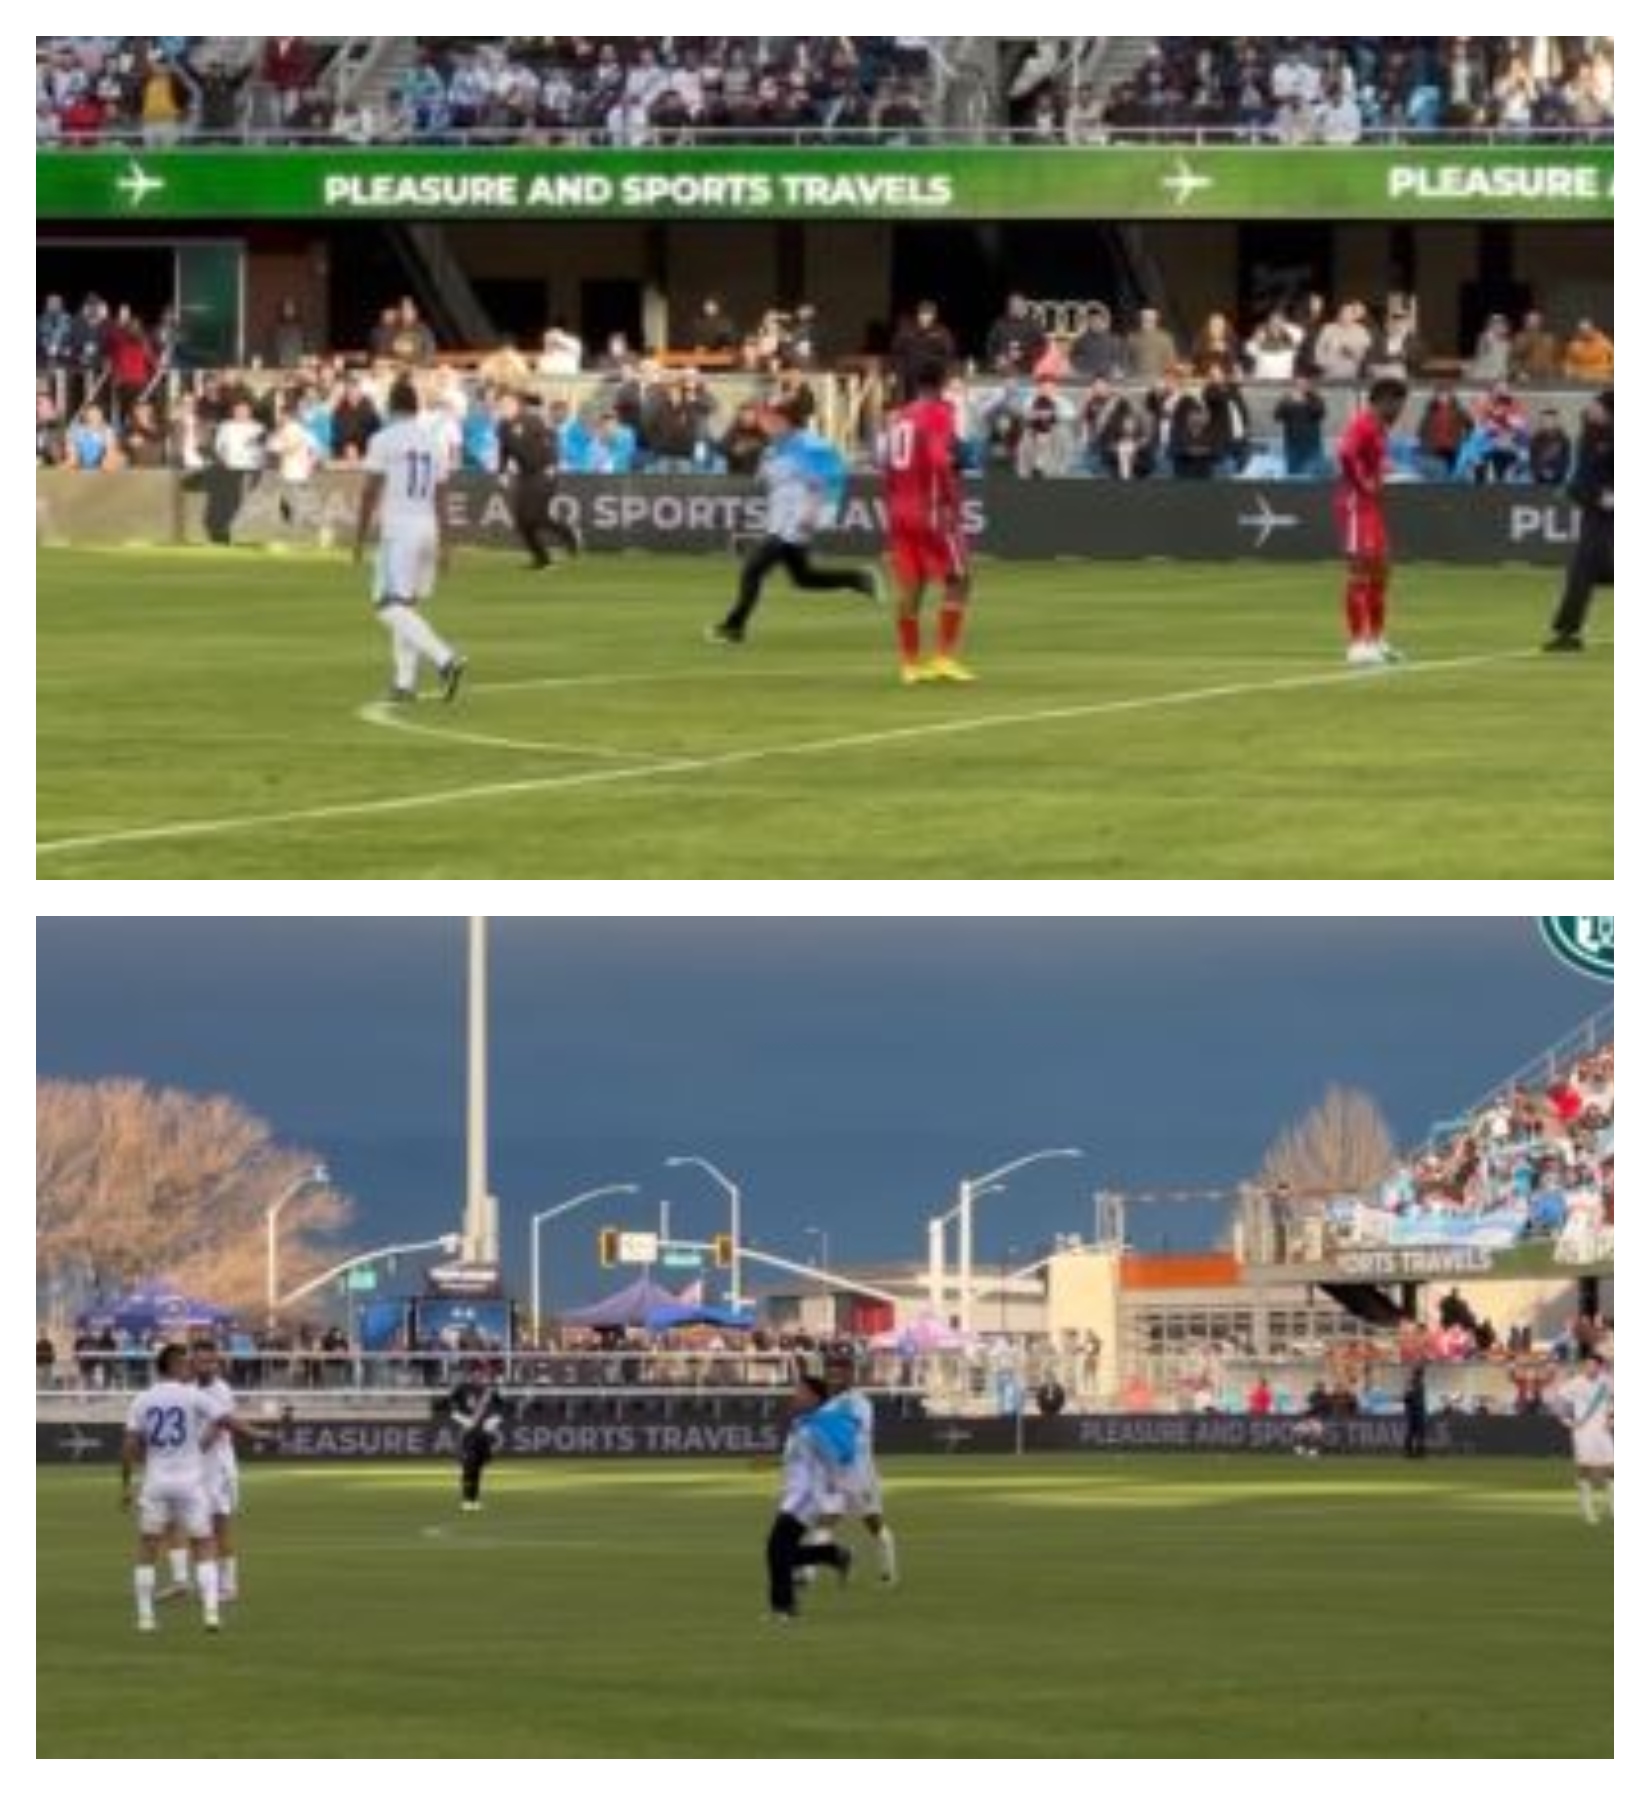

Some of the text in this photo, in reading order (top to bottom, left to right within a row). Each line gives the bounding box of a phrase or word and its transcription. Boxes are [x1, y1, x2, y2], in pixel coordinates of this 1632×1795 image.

[324, 173, 952, 205] PLEASURE AND SPORTS TRAVELS
[1388, 166, 1599, 199] PLEASURE
[594, 496, 766, 531] SPORTS
[146, 1406, 188, 1448] 23
[513, 1426, 635, 1452] SPORTS
[645, 1425, 780, 1450] TRAVELS
